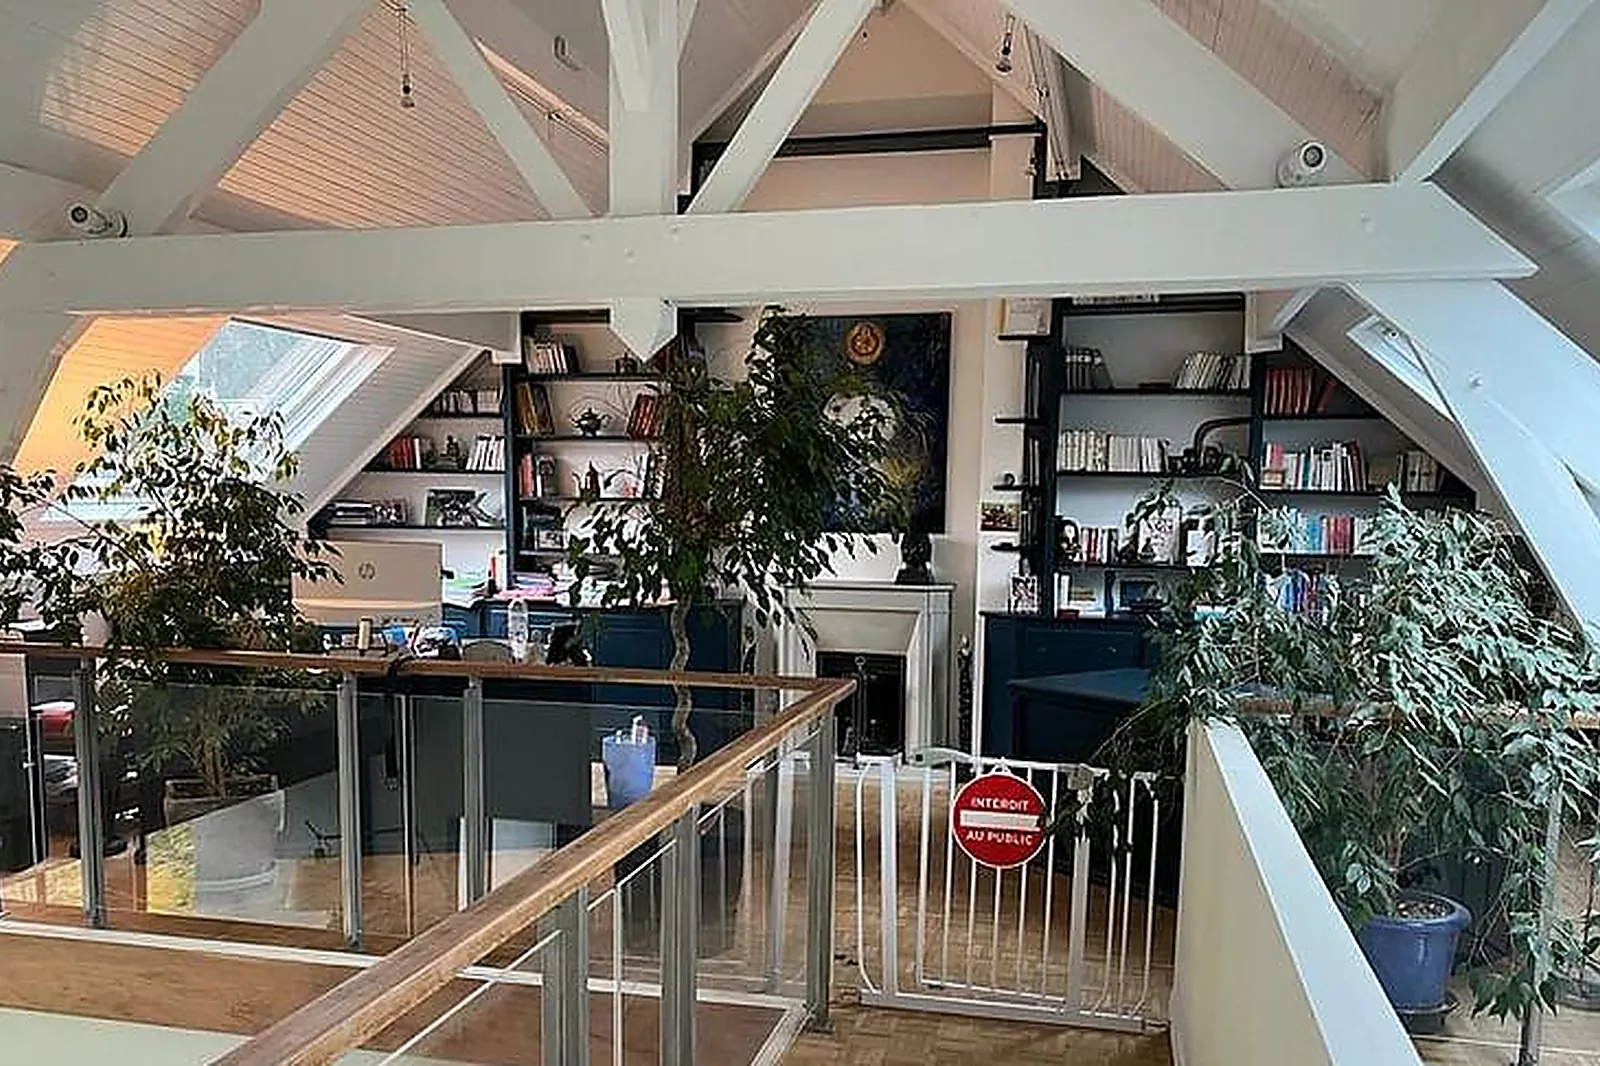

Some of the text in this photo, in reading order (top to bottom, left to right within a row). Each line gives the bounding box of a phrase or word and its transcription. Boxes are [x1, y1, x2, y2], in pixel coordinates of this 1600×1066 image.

[970, 797, 1029, 811] INTERDIT
[966, 830, 1033, 846] AU PUBLIC
